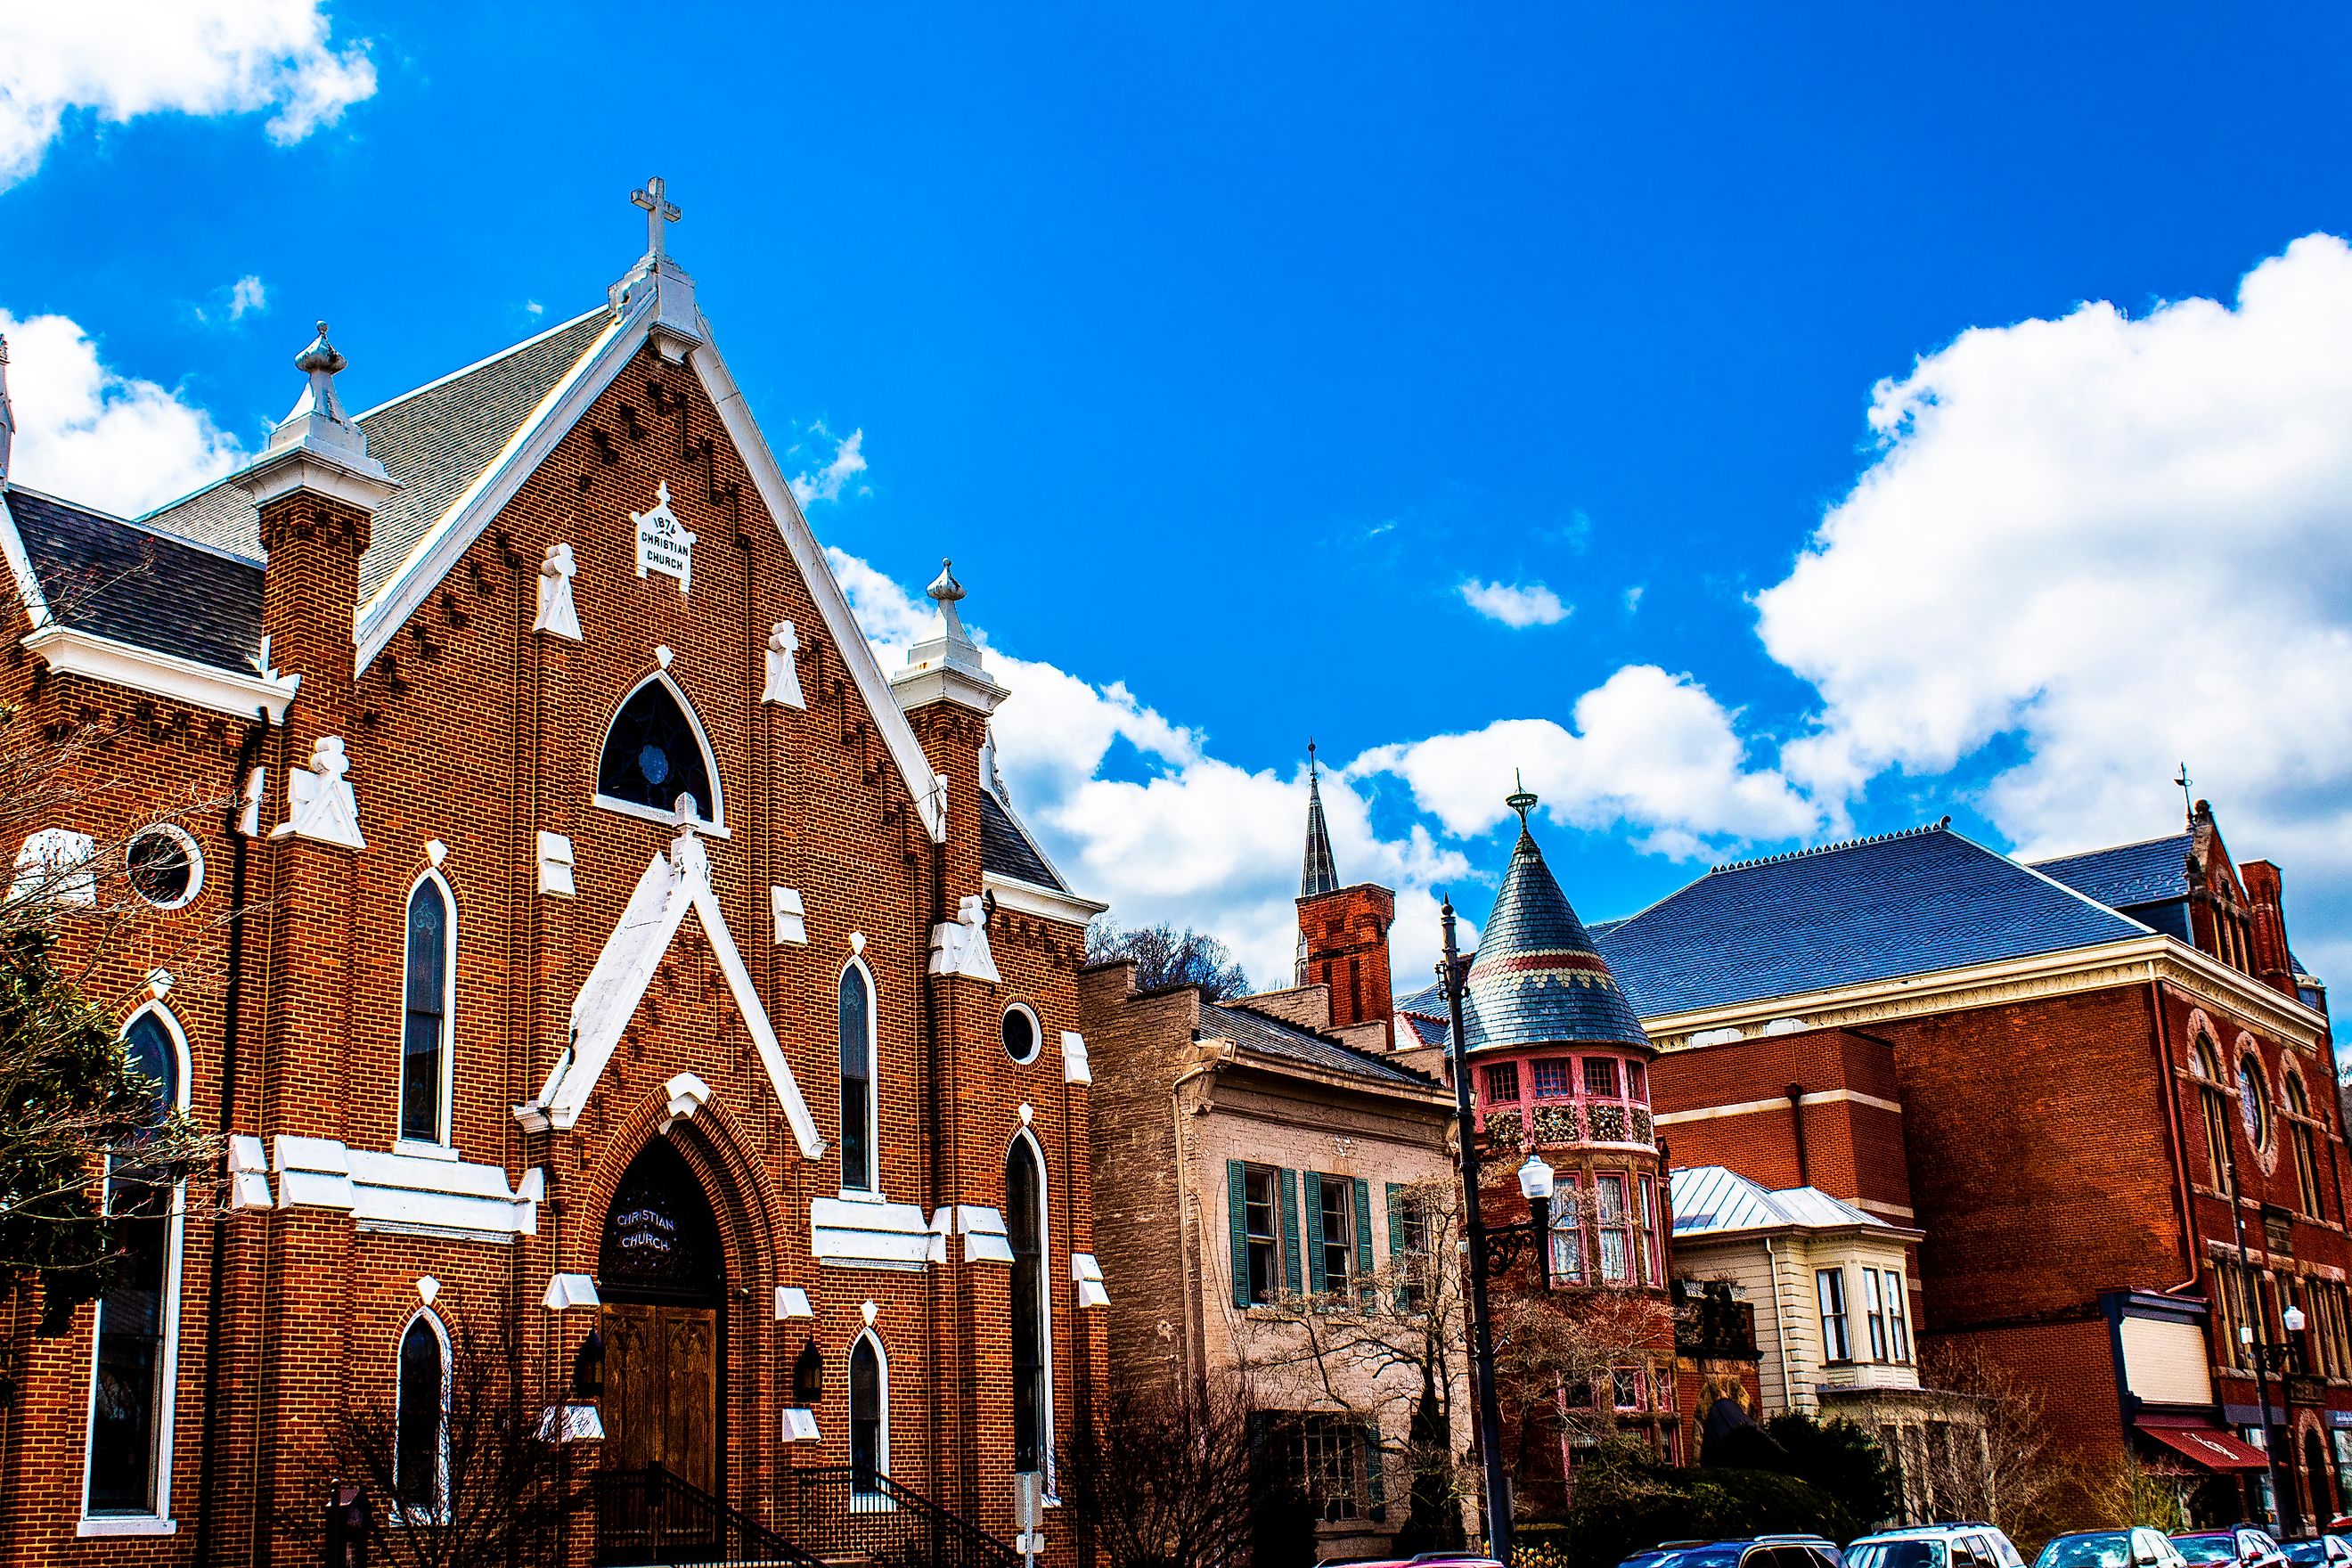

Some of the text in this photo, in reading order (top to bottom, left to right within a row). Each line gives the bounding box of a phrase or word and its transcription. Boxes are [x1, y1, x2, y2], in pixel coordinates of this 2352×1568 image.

[653, 518, 675, 534] 1876
[641, 532, 688, 556] CHRISTIAN
[647, 551, 682, 570] CHURCH
[617, 1210, 674, 1230] CHRISTIAN
